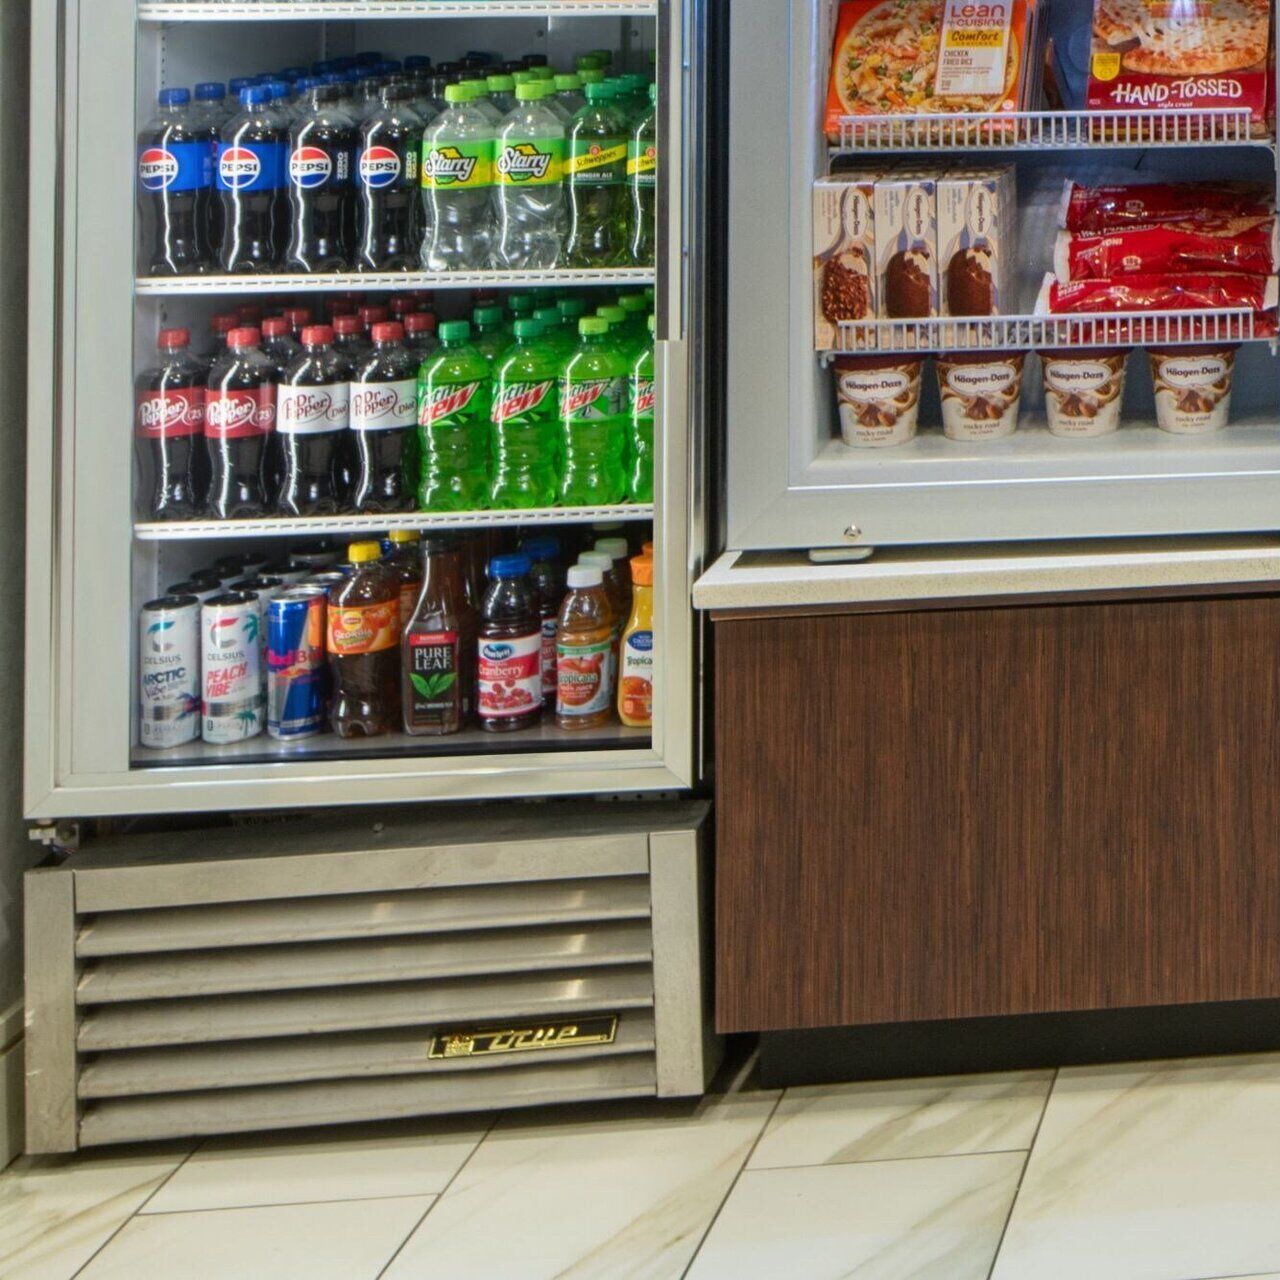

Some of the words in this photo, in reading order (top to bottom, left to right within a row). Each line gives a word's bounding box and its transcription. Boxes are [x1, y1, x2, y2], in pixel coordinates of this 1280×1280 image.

[951, 4, 1005, 18] Lean
[951, 30, 999, 42] Comfort
[1110, 78, 1243, 106] HAND-TOSSED
[140, 163, 175, 172] PEPSI
[221, 162, 258, 172] PEPSI
[292, 161, 329, 171] PEPSI
[362, 161, 398, 171] PEPSI
[425, 150, 476, 181] Starry
[498, 147, 552, 177] Starry
[207, 651, 245, 662] CELSIUS
[415, 647, 451, 659] PURE
[144, 654, 182, 665] CELSIUS
[415, 659, 451, 671] LEAF
[143, 667, 186, 684] ARCTIC
[206, 663, 249, 684] PEACH
[205, 681, 232, 698] VIBE
